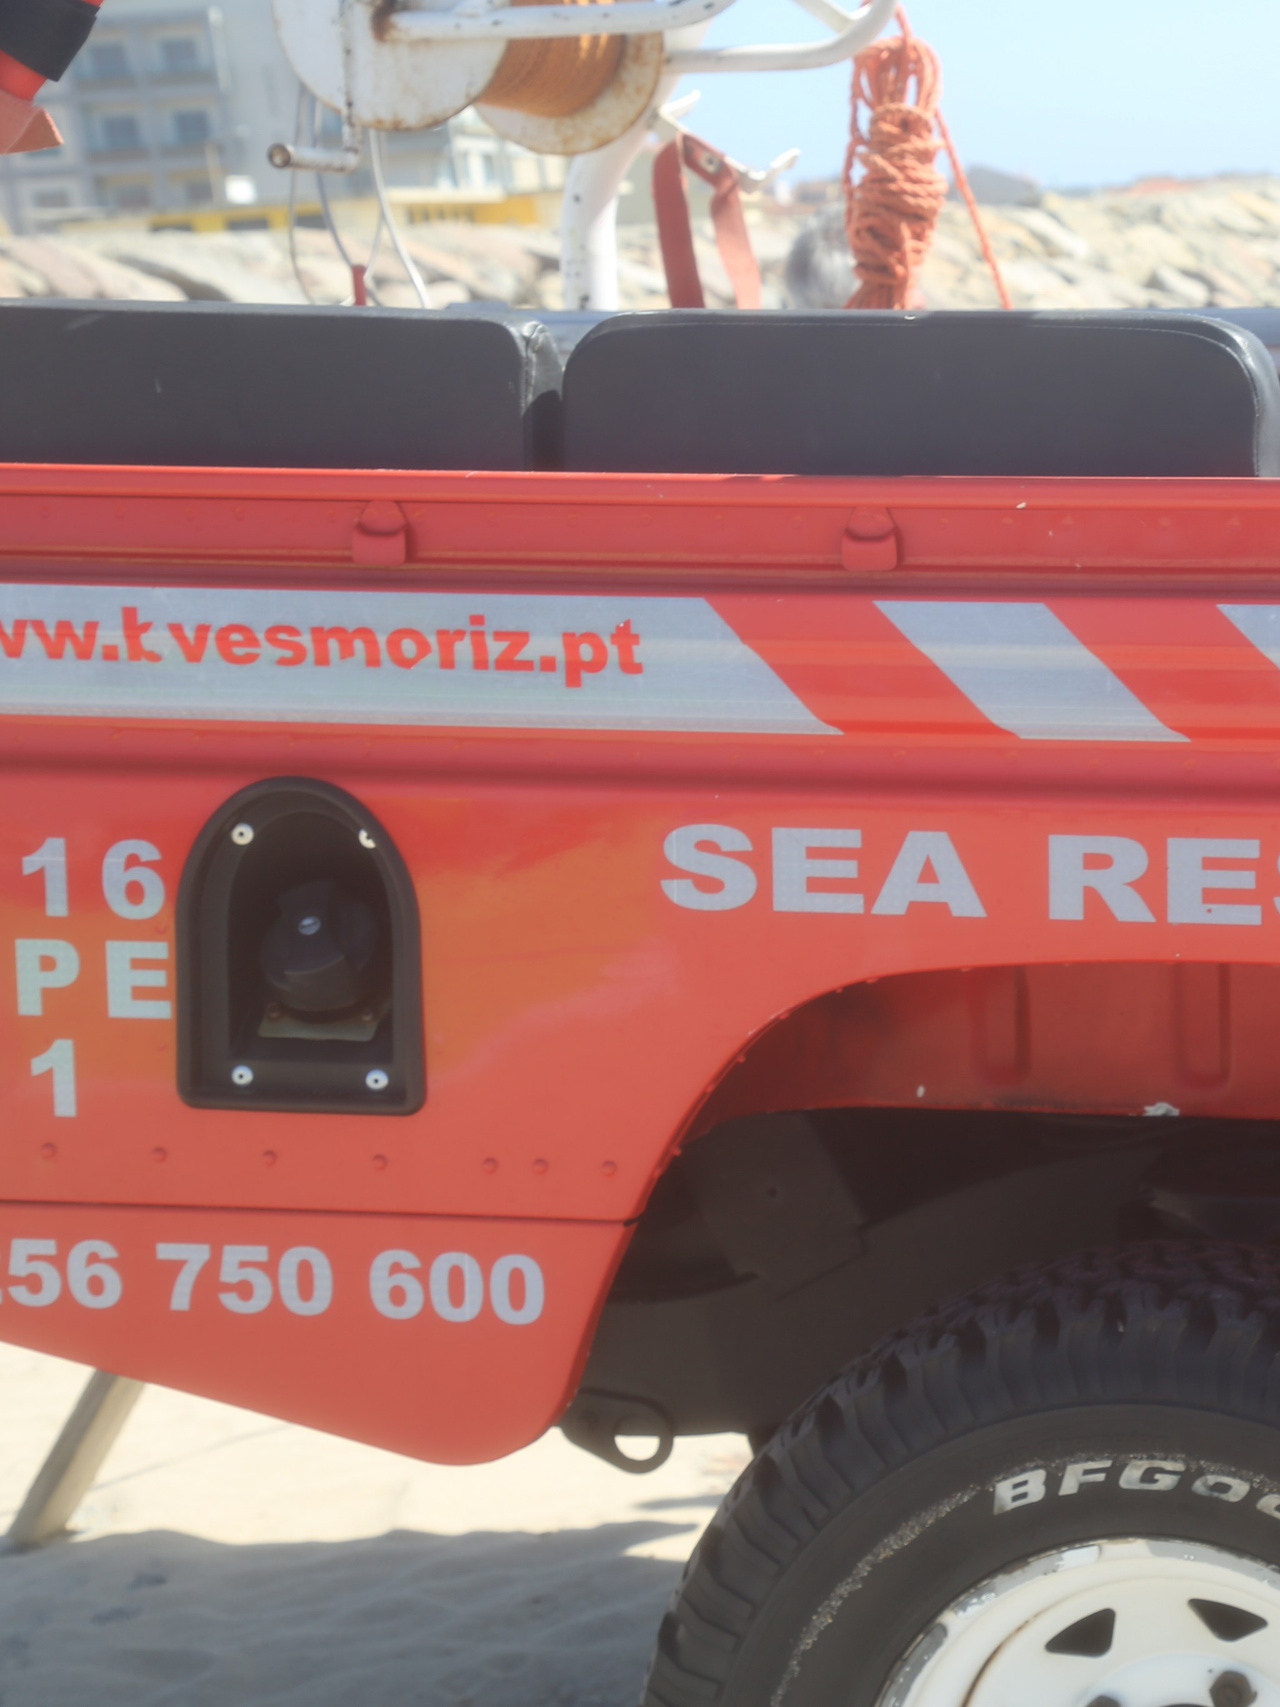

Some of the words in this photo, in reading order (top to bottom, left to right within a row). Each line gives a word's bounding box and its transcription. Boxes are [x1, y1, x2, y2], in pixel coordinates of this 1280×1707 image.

[22, 837, 166, 920] 16
[660, 823, 987, 918] SEA
[15, 938, 172, 1019] PE
[30, 1038, 77, 1117] 1
[0, 1238, 122, 1308] 56
[156, 1243, 333, 1316] 750
[369, 1249, 545, 1325] 600
